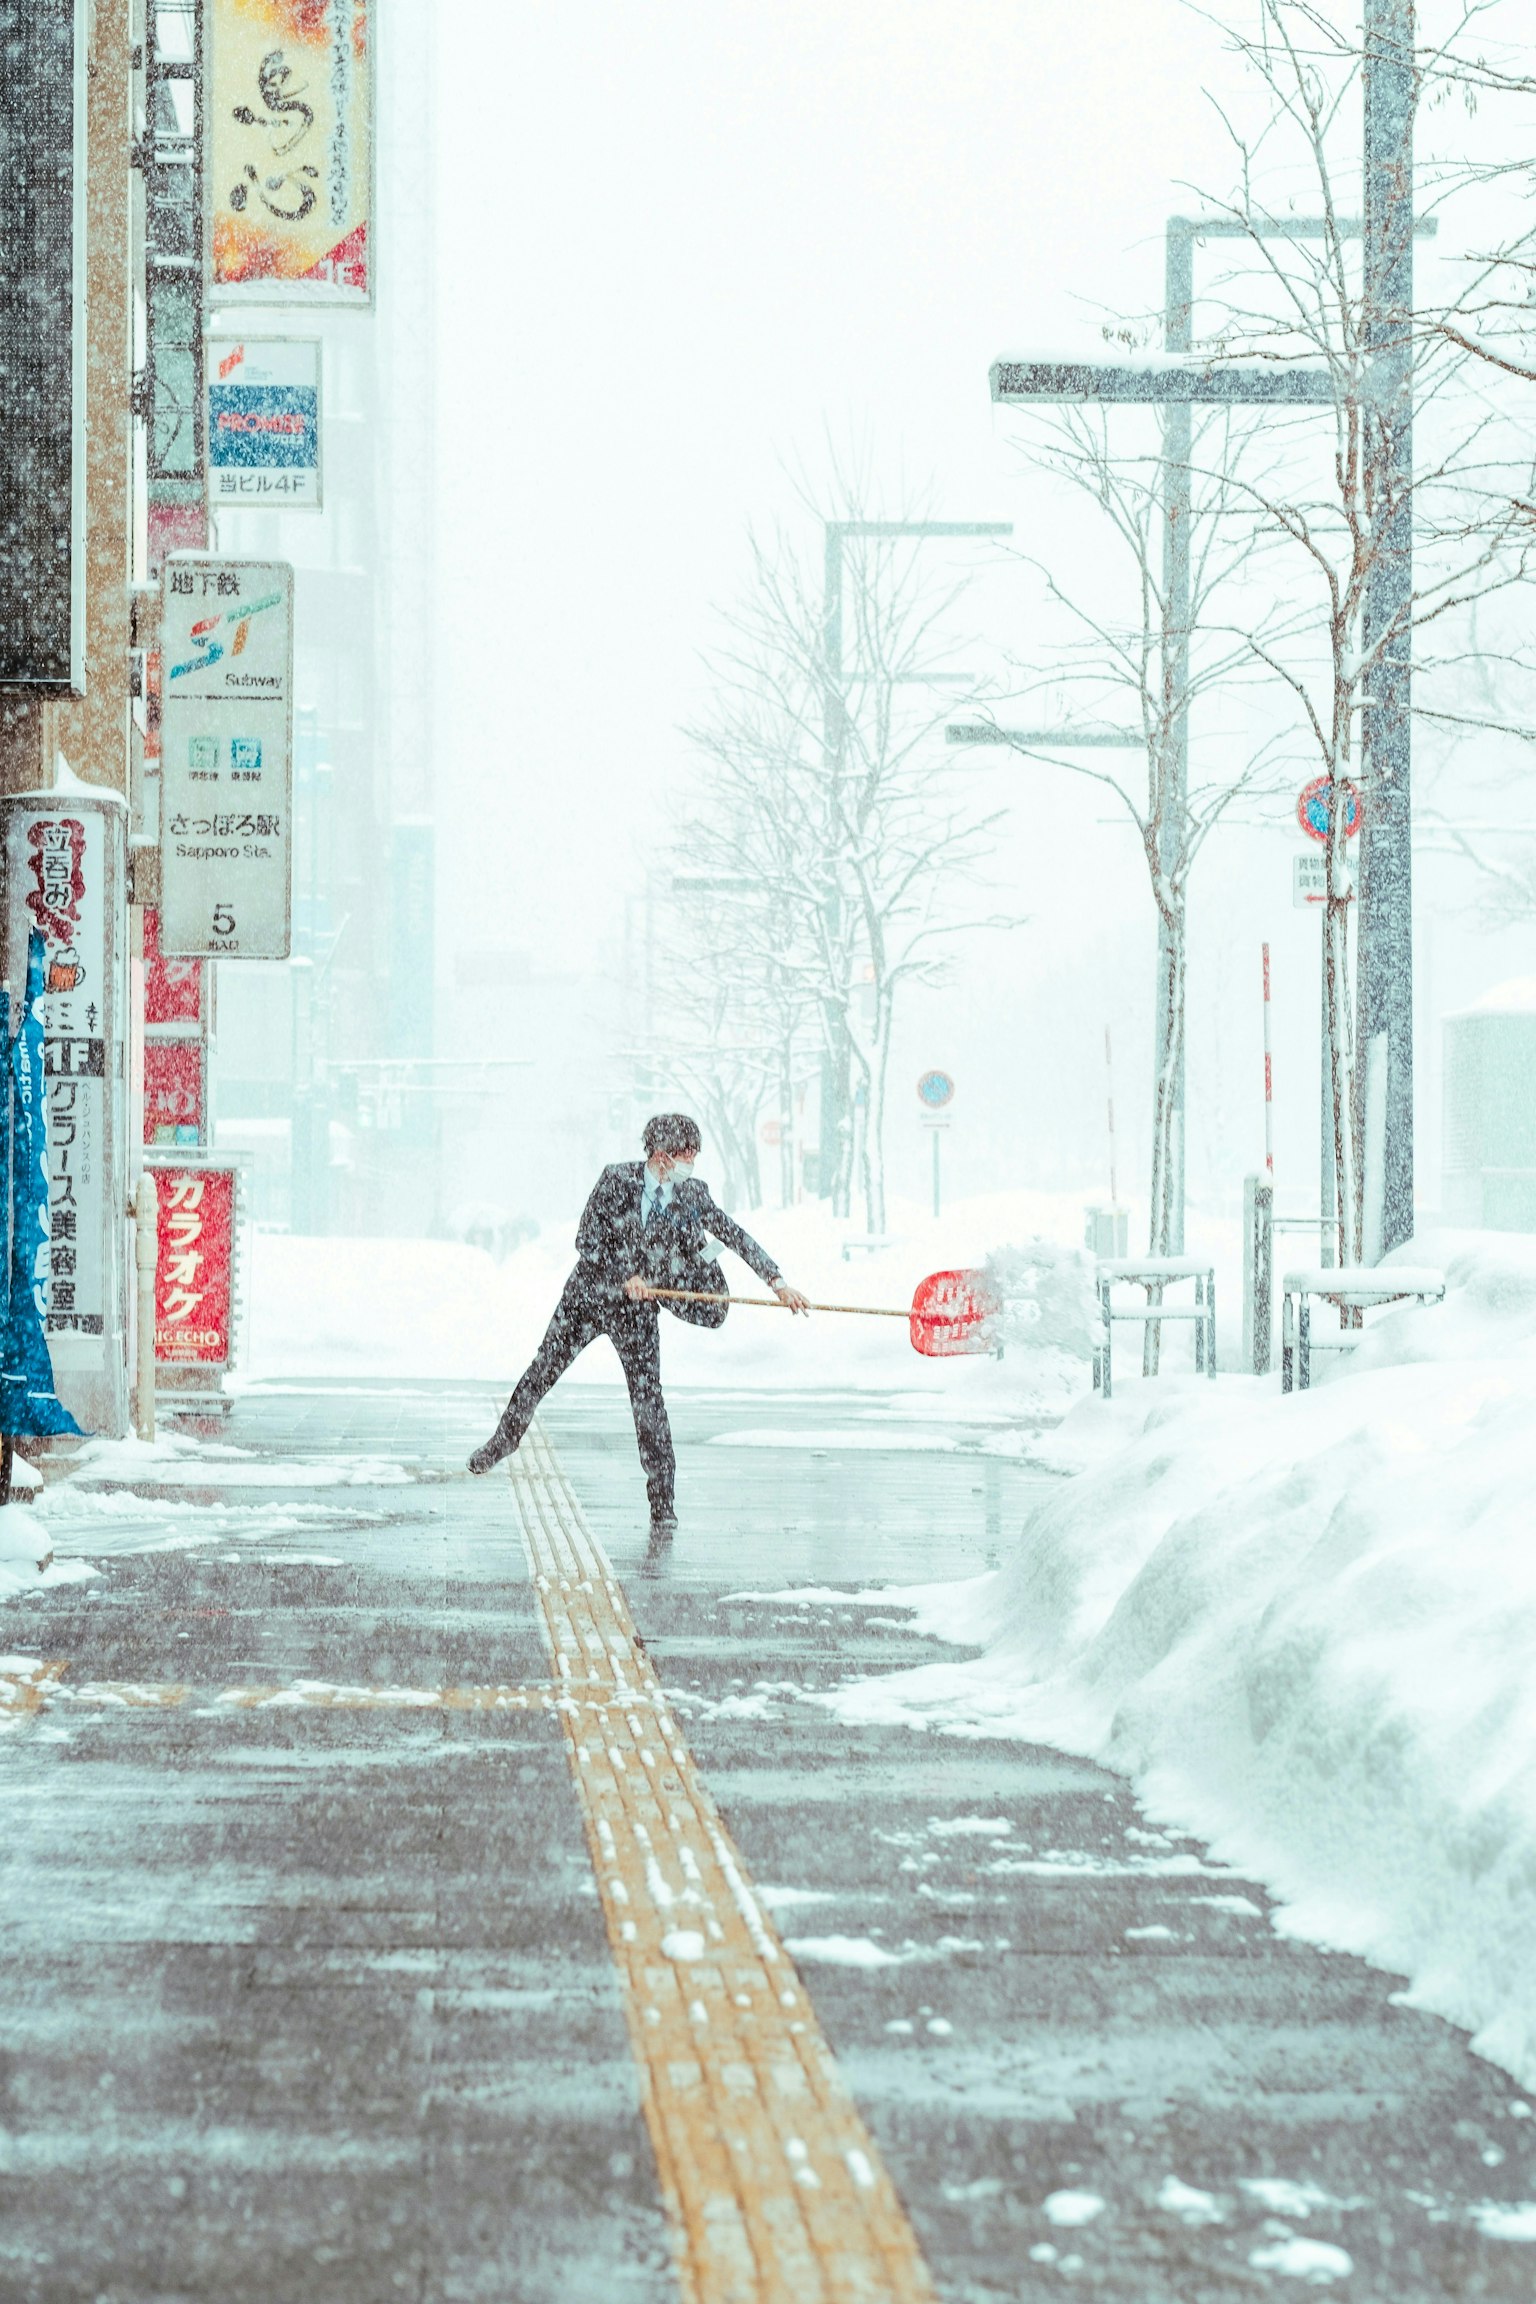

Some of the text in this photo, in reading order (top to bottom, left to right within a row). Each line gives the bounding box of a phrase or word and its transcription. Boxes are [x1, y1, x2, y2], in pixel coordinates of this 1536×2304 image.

[217, 411, 305, 434] PROMISE
[219, 473, 306, 494] 当ビル4F
[170, 571, 240, 596] 地下鉄
[225, 673, 282, 689] Subway
[176, 844, 239, 860] Sapporo
[45, 827, 70, 907] 立呑み
[212, 903, 236, 936] 5
[45, 1042, 90, 1072] 1F
[162, 1174, 205, 1322] カラオケ
[154, 1330, 220, 1347] IG ECHO
